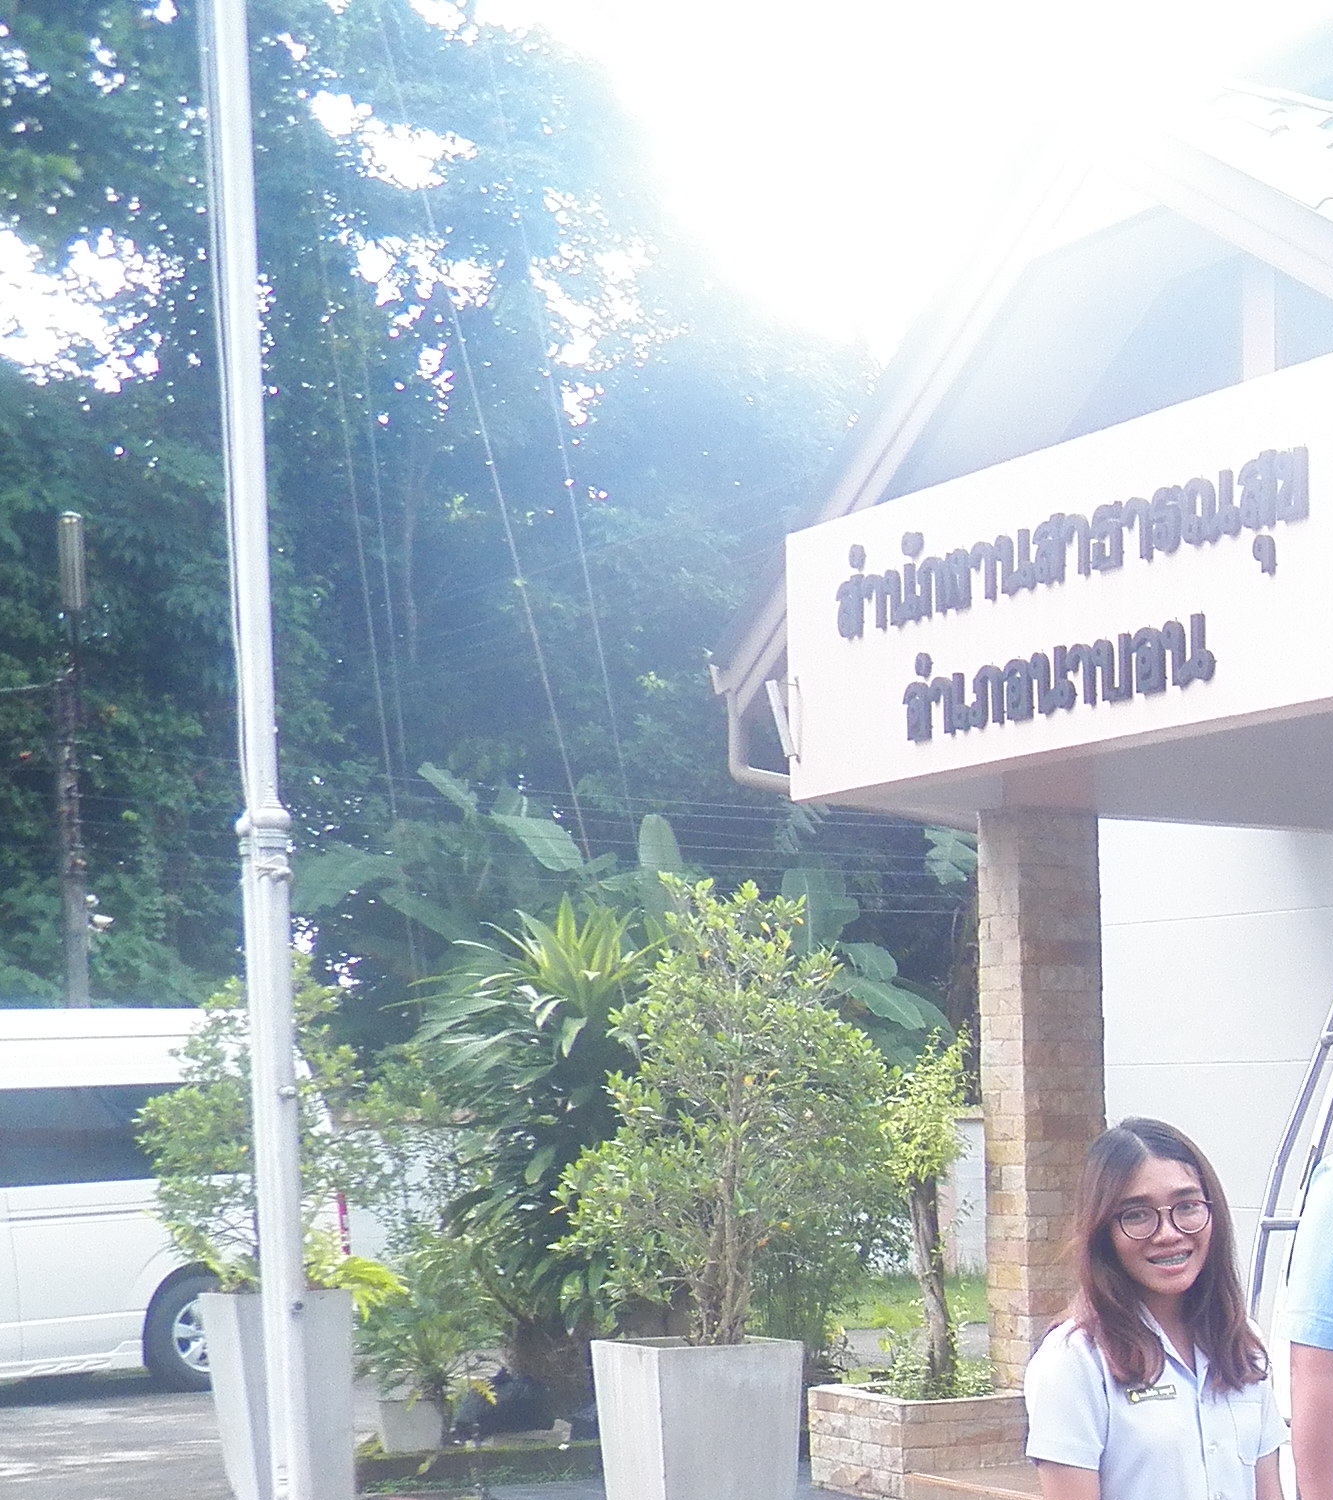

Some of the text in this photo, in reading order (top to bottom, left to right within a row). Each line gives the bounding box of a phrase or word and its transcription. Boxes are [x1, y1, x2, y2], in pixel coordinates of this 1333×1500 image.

[836, 446, 1309, 637] สำนักงานสาธารณสุข
[903, 611, 1216, 742] อำเภอนาบอน
